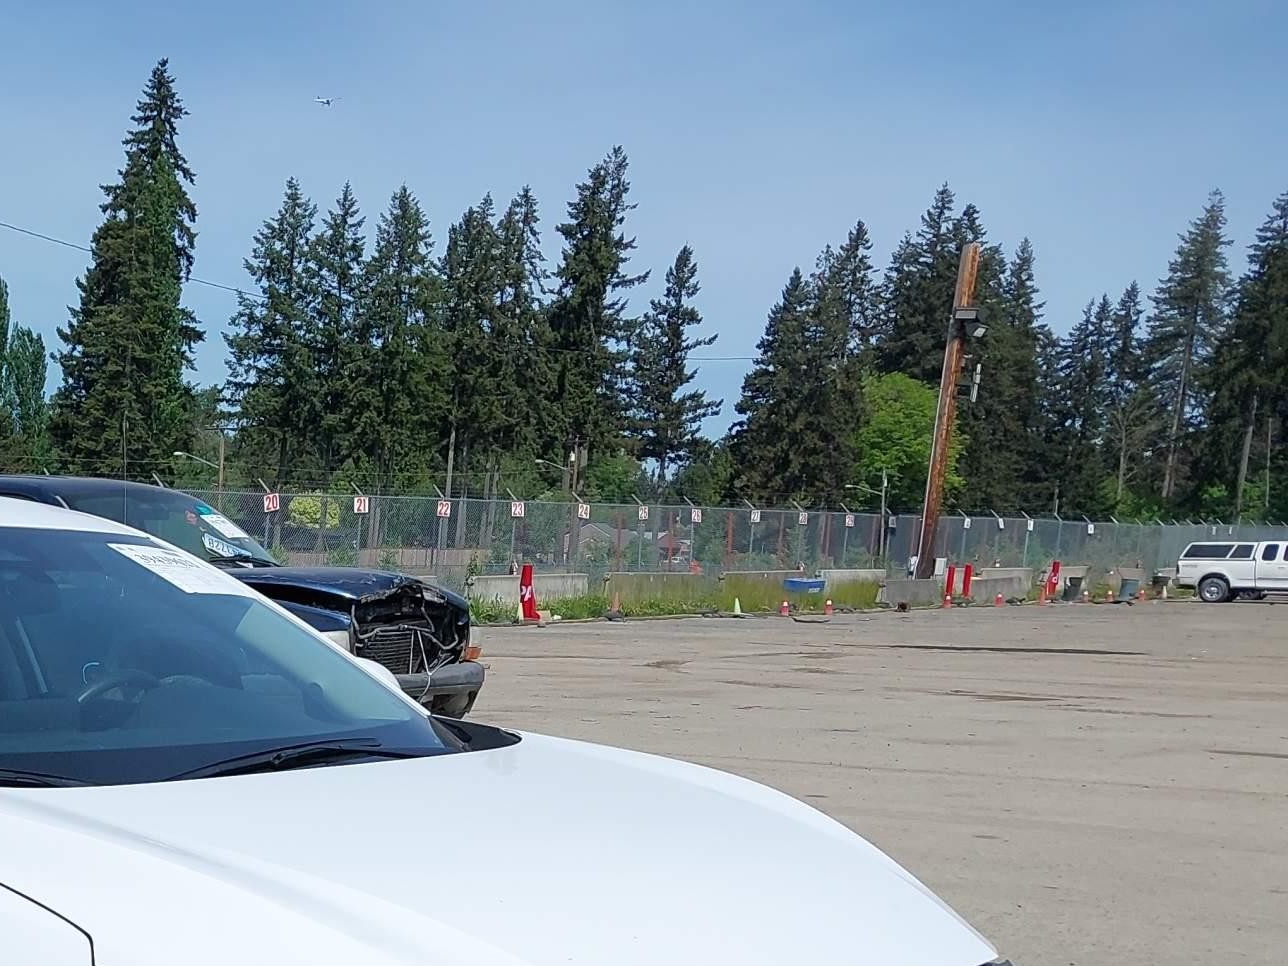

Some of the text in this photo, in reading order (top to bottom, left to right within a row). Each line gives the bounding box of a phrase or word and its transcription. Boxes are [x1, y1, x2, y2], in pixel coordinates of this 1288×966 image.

[265, 494, 278, 511] 20
[356, 498, 366, 512] 21
[438, 502, 450, 516] 22
[512, 502, 523, 516] 23
[579, 504, 590, 518] 24
[639, 507, 648, 519] 25
[692, 510, 701, 522] 26
